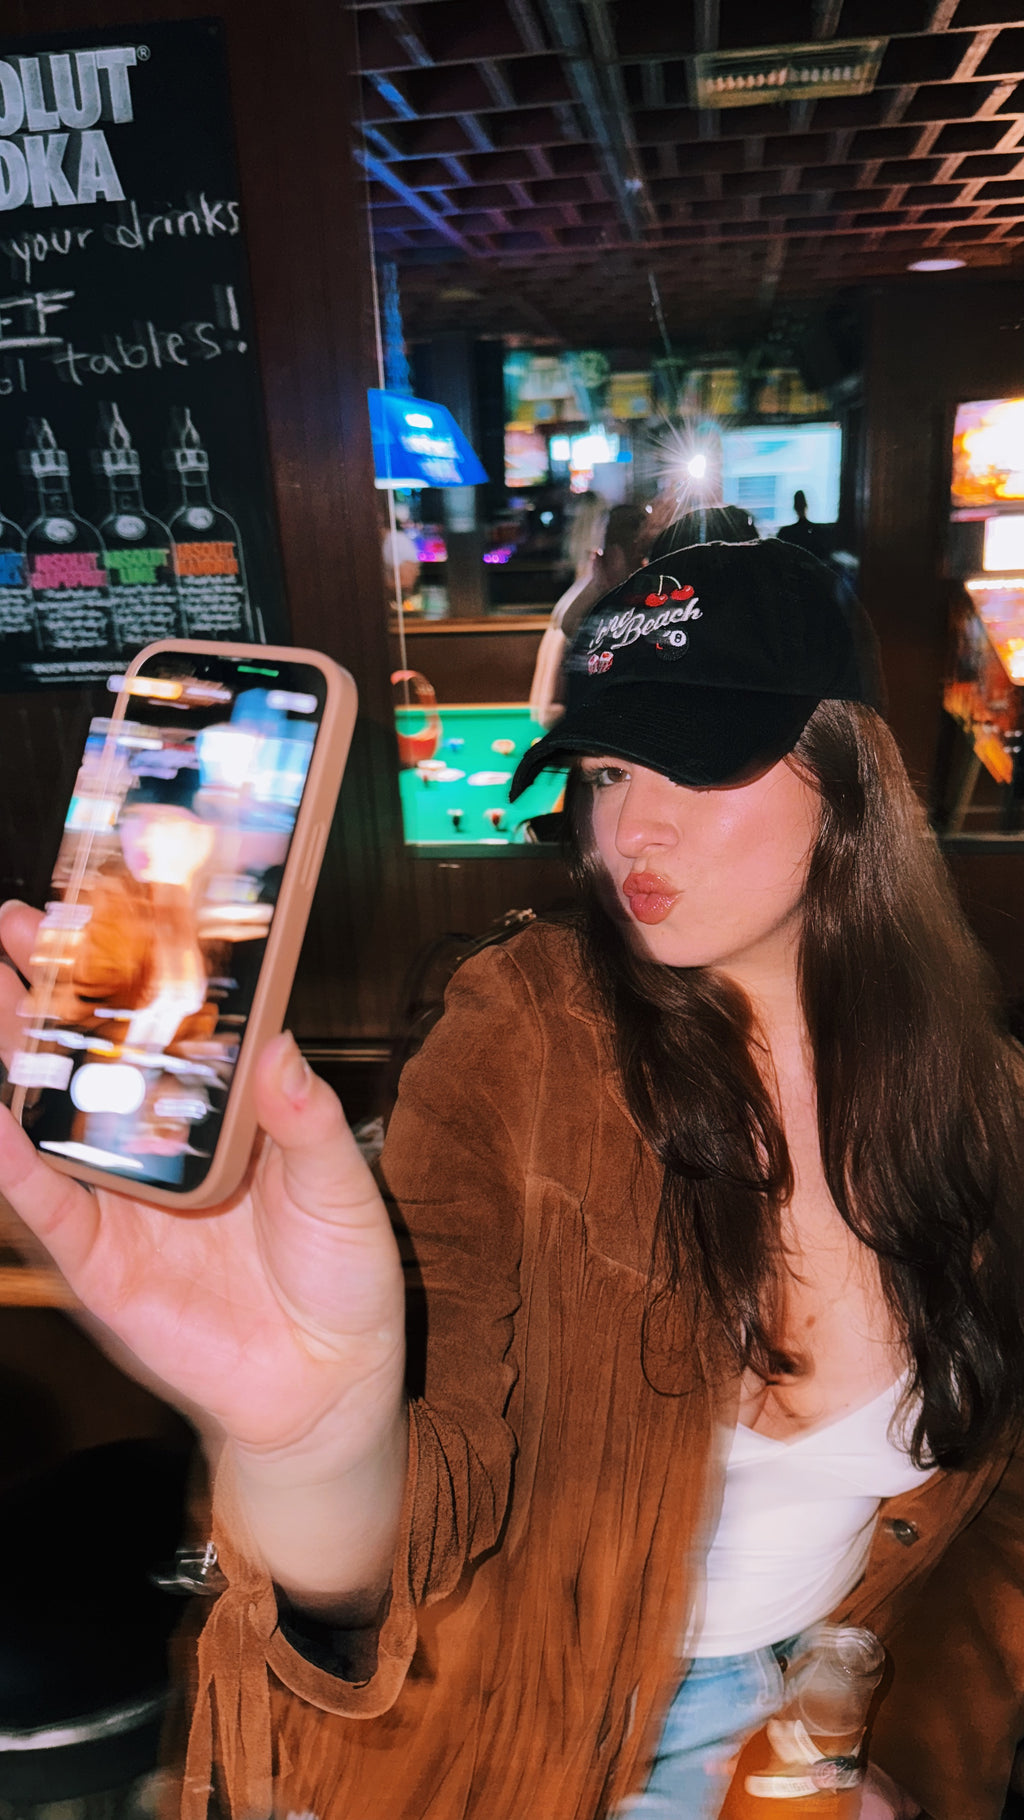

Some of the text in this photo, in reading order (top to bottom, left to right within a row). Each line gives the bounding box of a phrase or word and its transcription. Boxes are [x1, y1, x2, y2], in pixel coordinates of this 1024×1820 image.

[11, 192, 240, 283] your drinks
[53, 286, 248, 385] tables!
[611, 597, 703, 650] Beach
